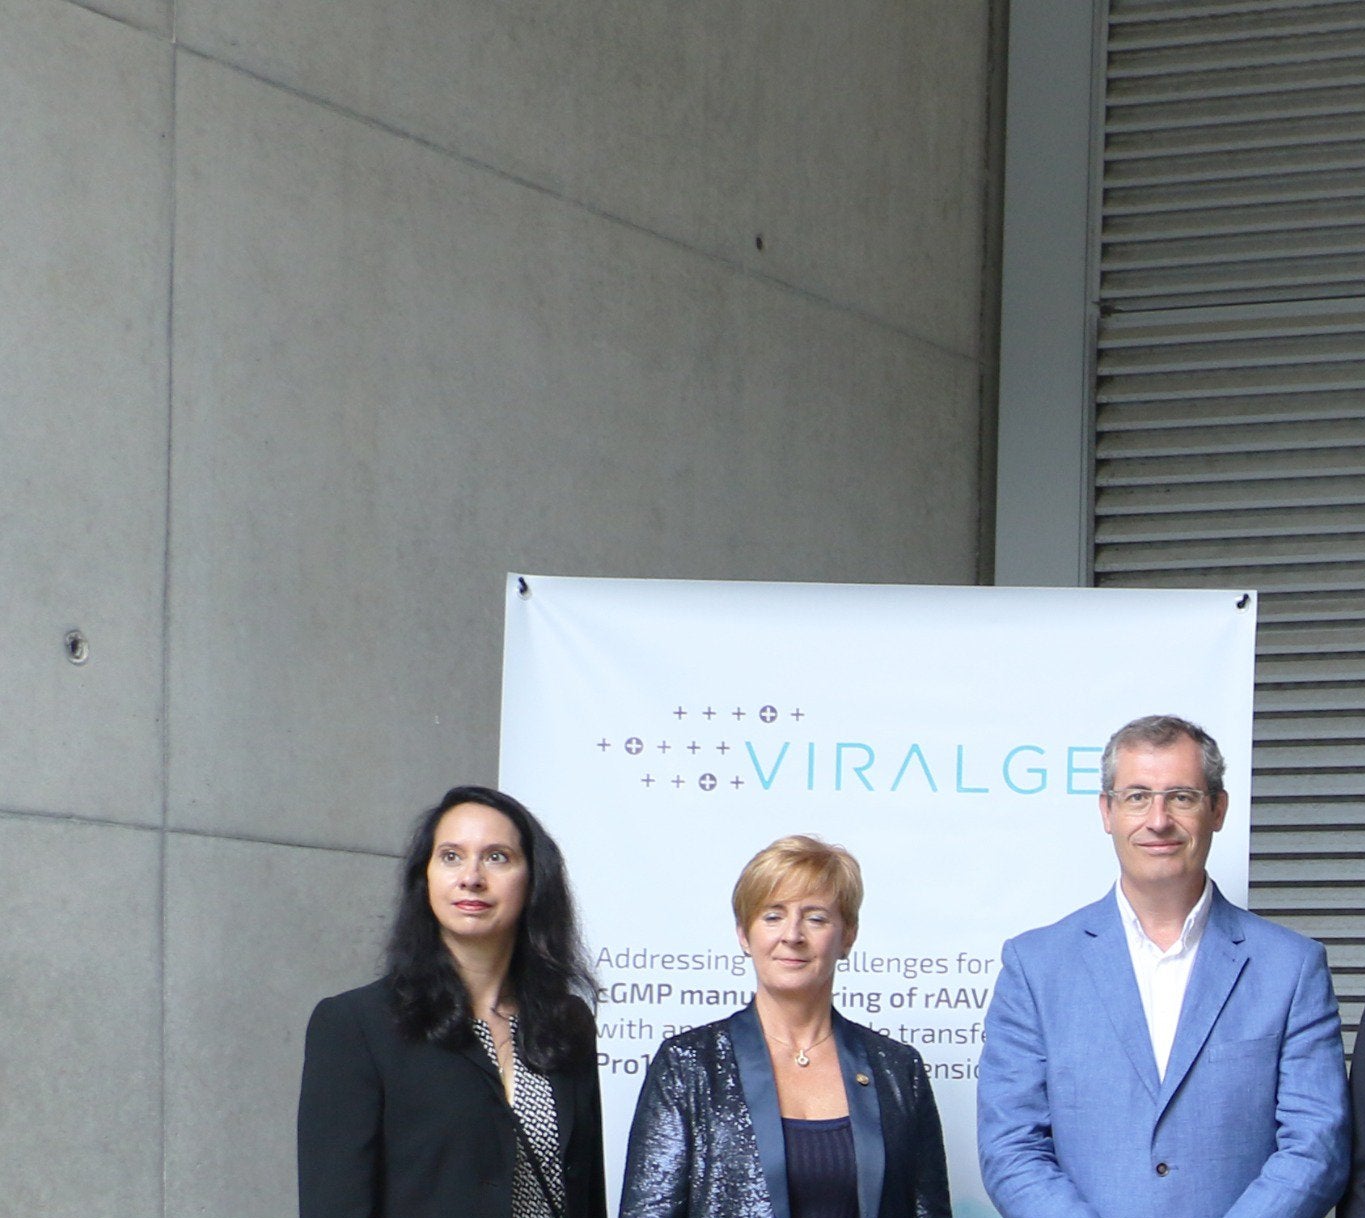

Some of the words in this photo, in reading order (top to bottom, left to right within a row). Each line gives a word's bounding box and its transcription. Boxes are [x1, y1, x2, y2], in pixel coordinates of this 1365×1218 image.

[744, 740, 1103, 796] VIRALGE
[595, 947, 747, 976] Addressing
[837, 951, 949, 979] allenges
[956, 952, 994, 975] for
[596, 983, 672, 1005] cGMP
[890, 986, 918, 1008] of
[924, 988, 989, 1009] rAAV
[596, 1018, 653, 1040] with
[899, 1022, 987, 1045] transf
[597, 1053, 650, 1075] Pro1
